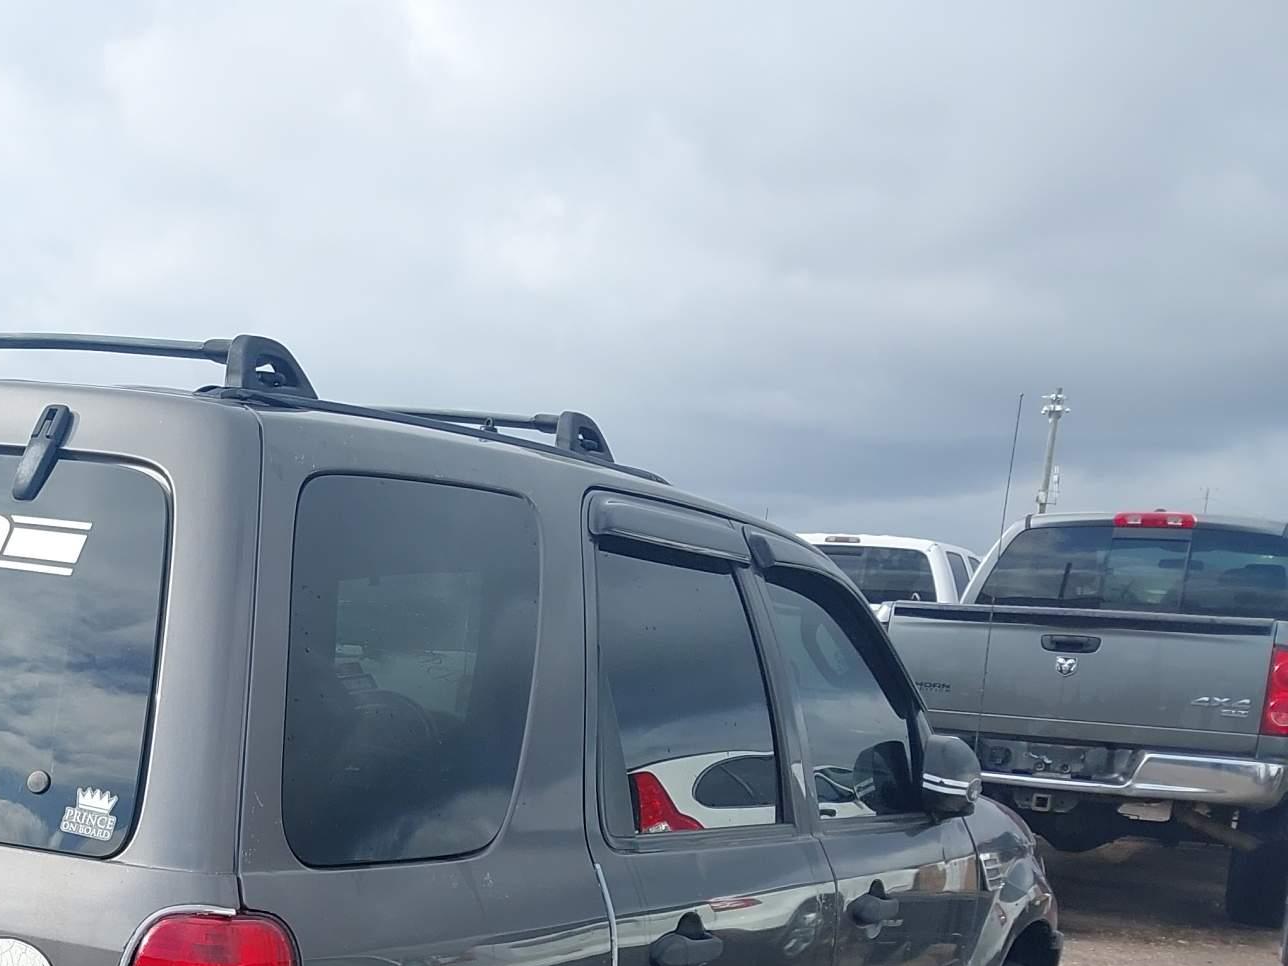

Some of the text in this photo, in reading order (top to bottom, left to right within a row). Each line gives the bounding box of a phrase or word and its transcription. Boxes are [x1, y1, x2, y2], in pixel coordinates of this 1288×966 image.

[65, 809, 115, 830] PRINCE
[62, 821, 111, 839] ON BOARD
